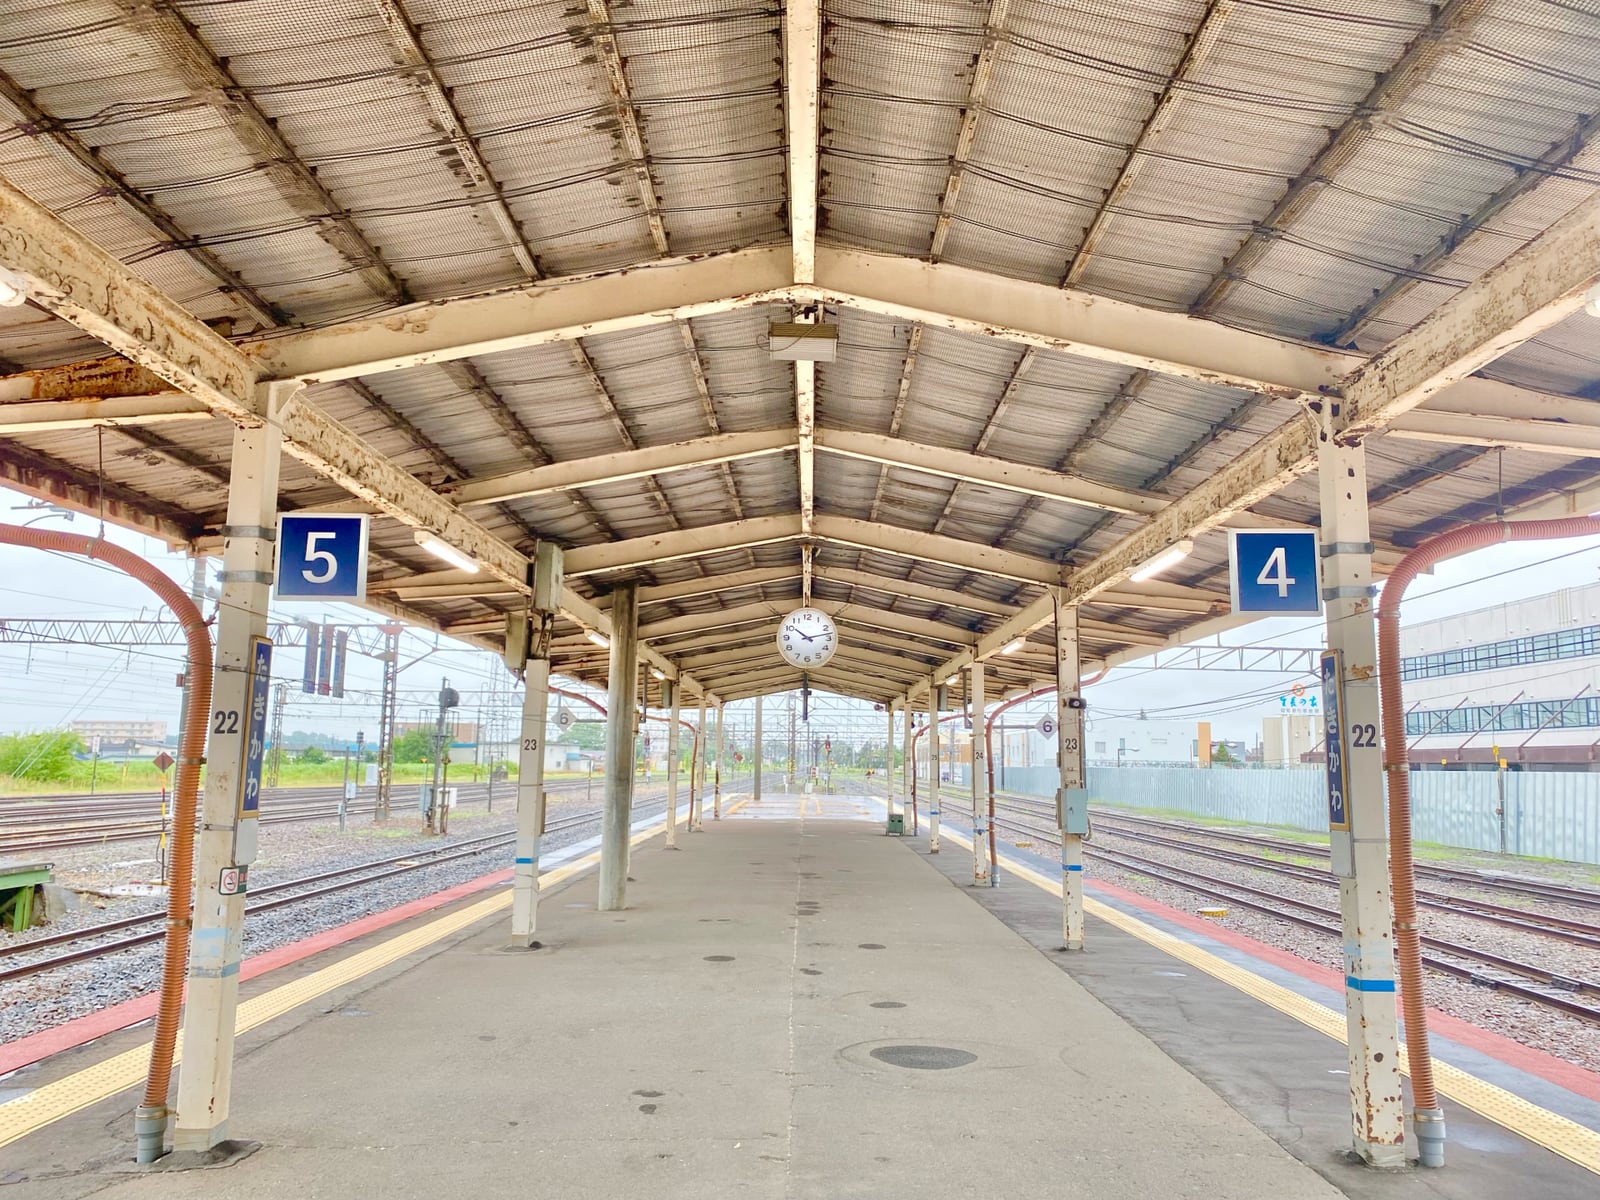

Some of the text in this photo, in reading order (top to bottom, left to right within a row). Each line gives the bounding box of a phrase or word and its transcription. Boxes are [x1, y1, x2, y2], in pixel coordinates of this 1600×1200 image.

[302, 532, 338, 584] 5
[1256, 547, 1296, 597] 4
[214, 711, 239, 734] 22
[246, 653, 268, 800] たきかわ
[560, 713, 569, 724] 6
[1043, 721, 1052, 732] 6
[524, 738, 537, 751] 23
[1065, 738, 1078, 750] 23
[1324, 668, 1342, 812] たきかわ
[1352, 724, 1376, 747] 22
[975, 751, 984, 759] 24
